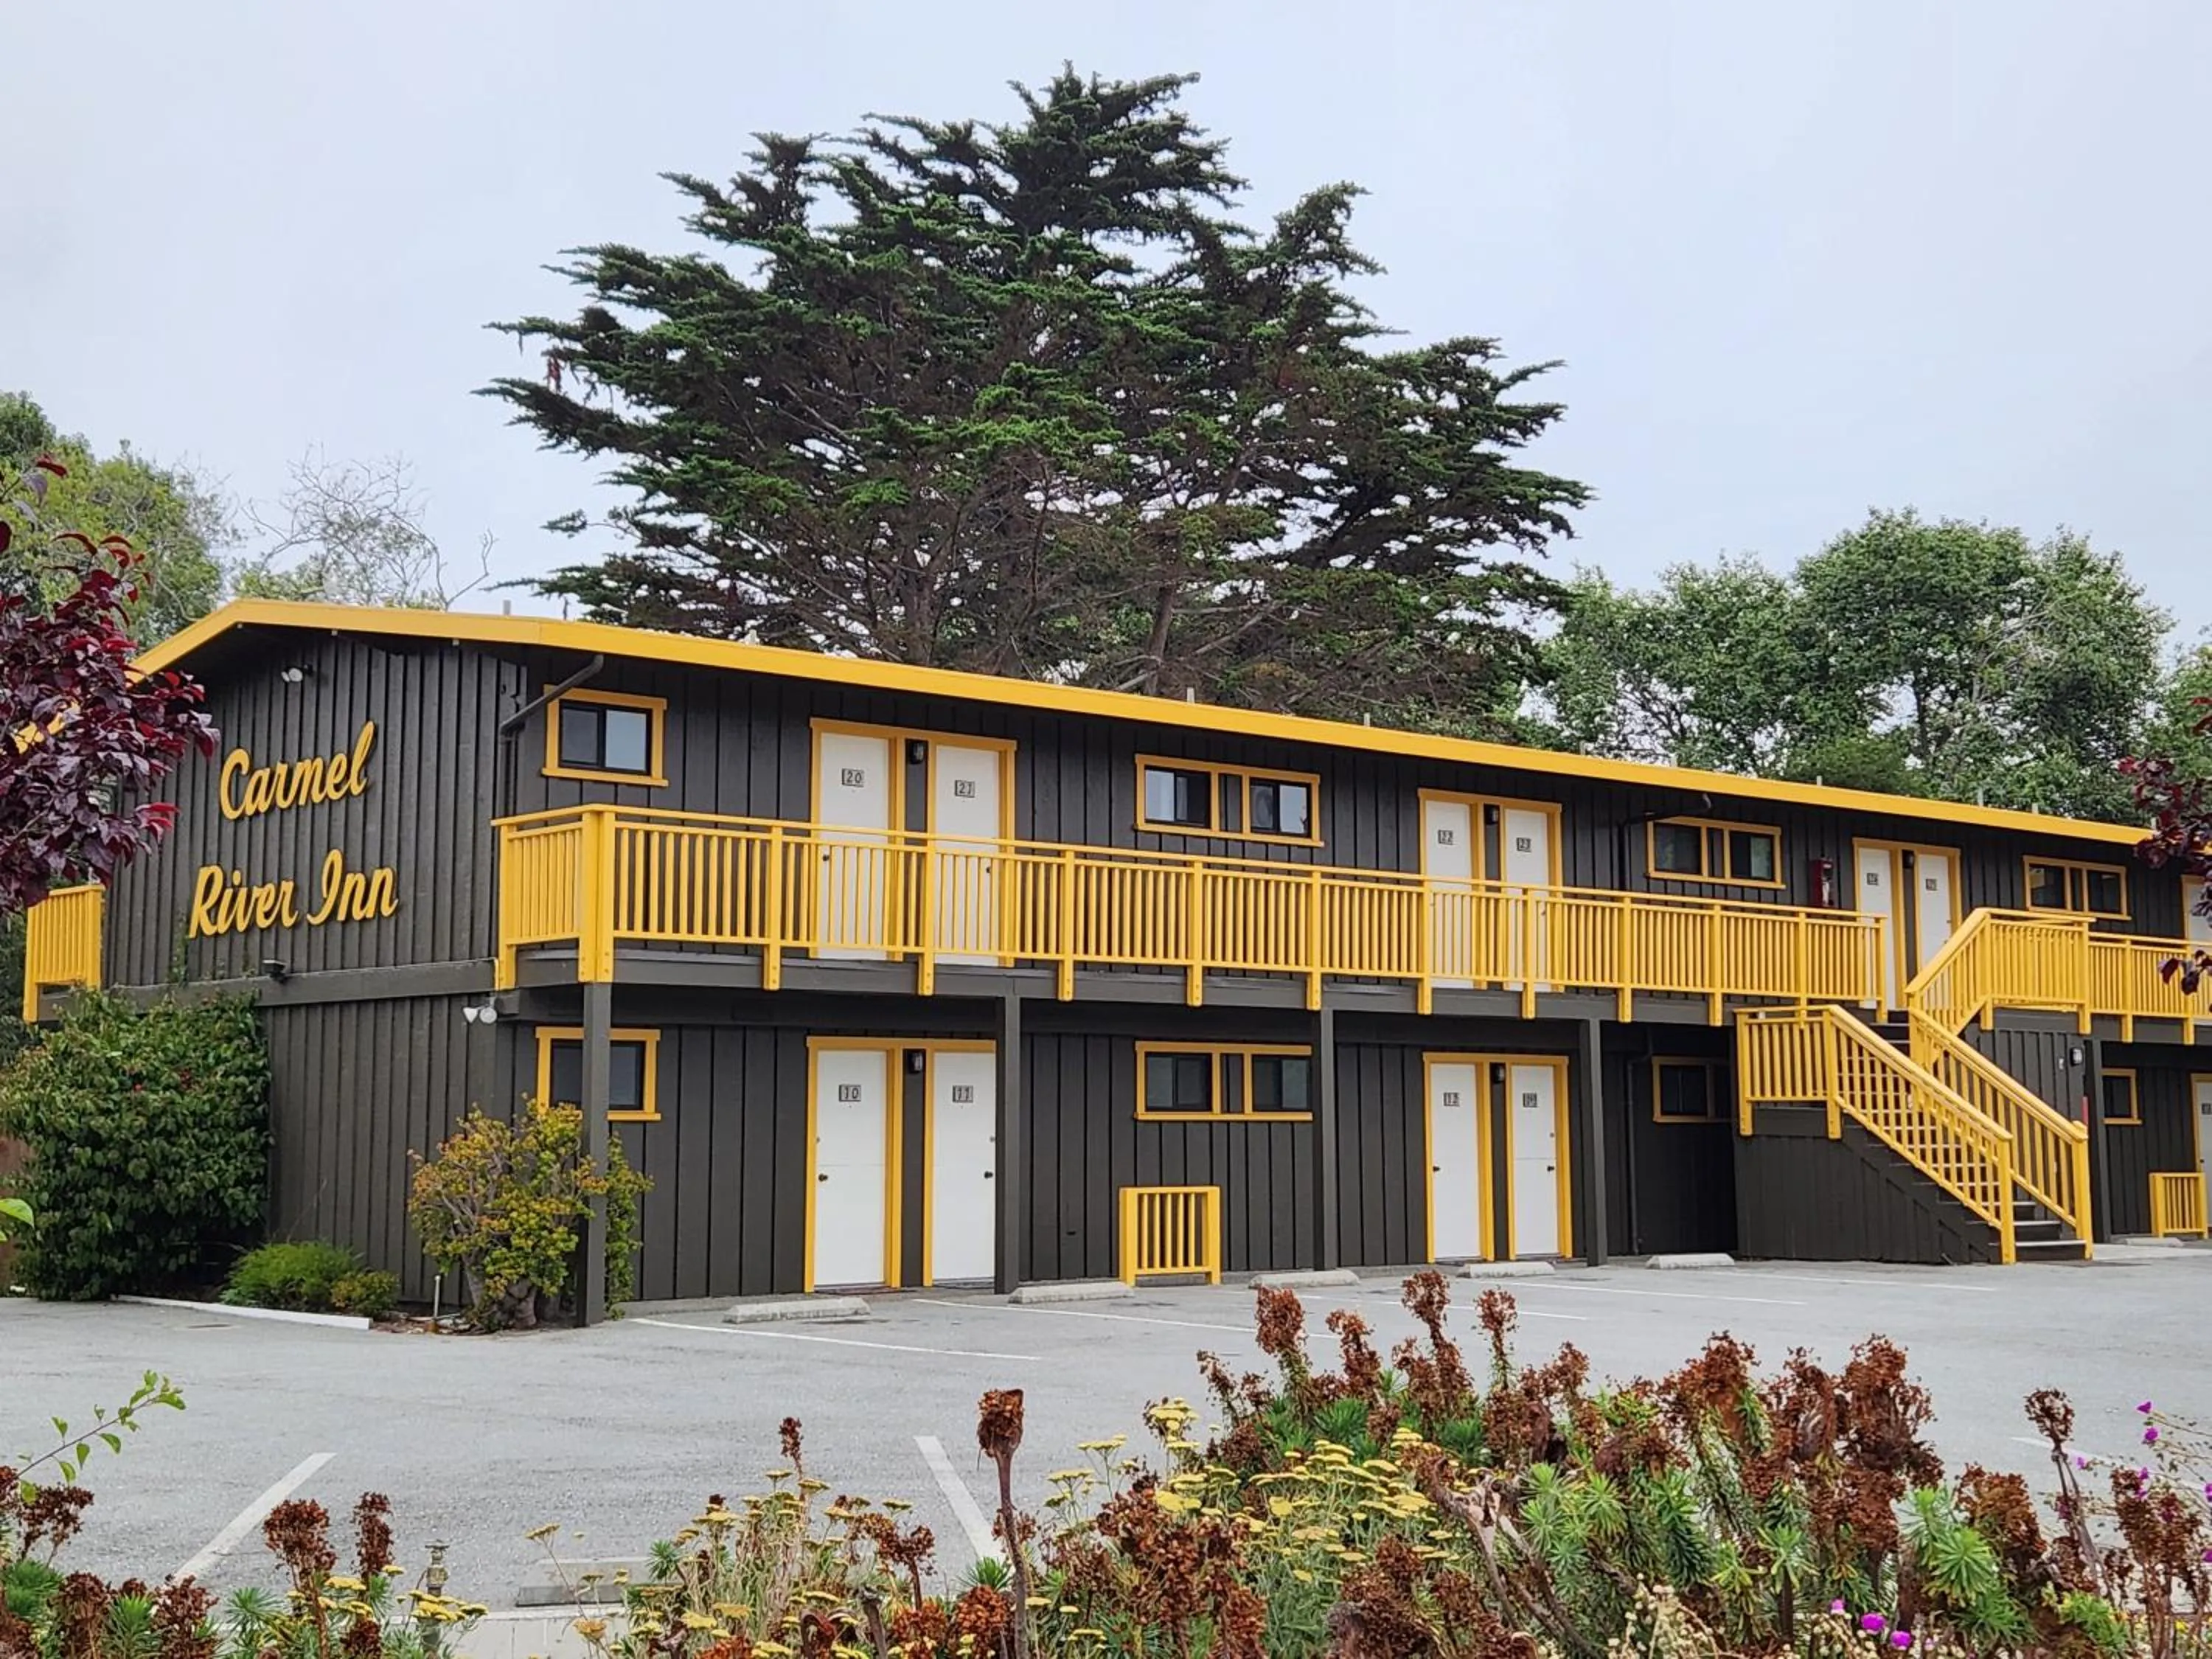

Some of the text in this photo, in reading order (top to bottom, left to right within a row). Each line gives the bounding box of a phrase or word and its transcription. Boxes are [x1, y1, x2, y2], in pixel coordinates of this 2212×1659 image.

[220, 720, 375, 821] Carmel
[846, 770, 863, 784] 20
[188, 849, 399, 939] River Inn
[844, 1086, 859, 1099] 10
